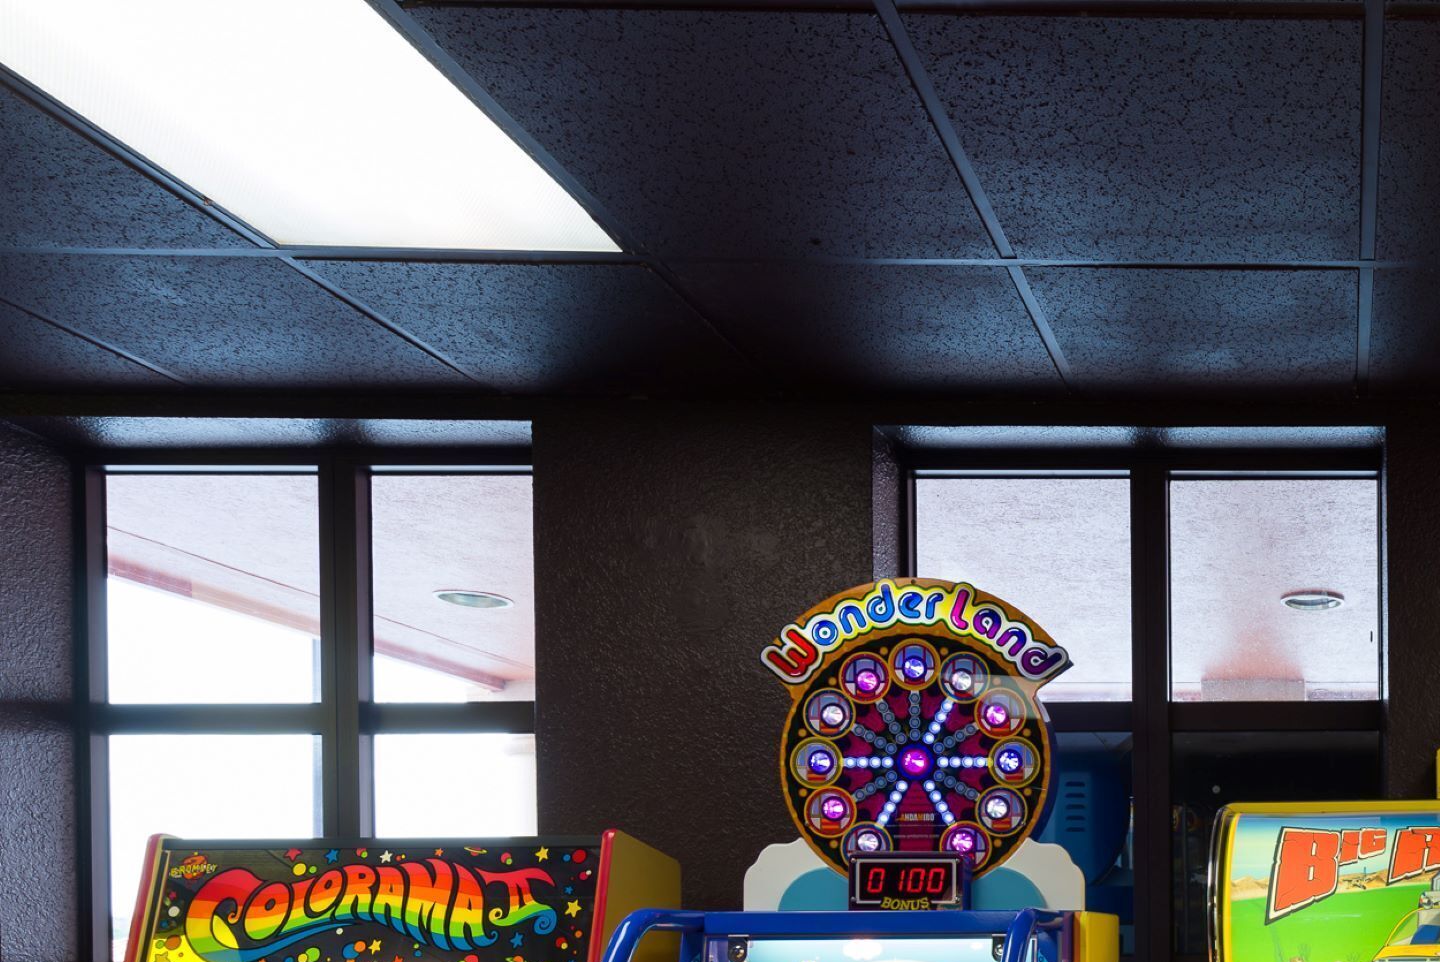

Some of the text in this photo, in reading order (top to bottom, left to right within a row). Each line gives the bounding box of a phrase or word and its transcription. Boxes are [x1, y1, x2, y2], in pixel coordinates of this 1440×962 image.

[765, 583, 1064, 679] Wonder Land
[168, 863, 218, 878] BROMLEY
[1265, 826, 1387, 925] BIG
[880, 896, 930, 911] BONUS
